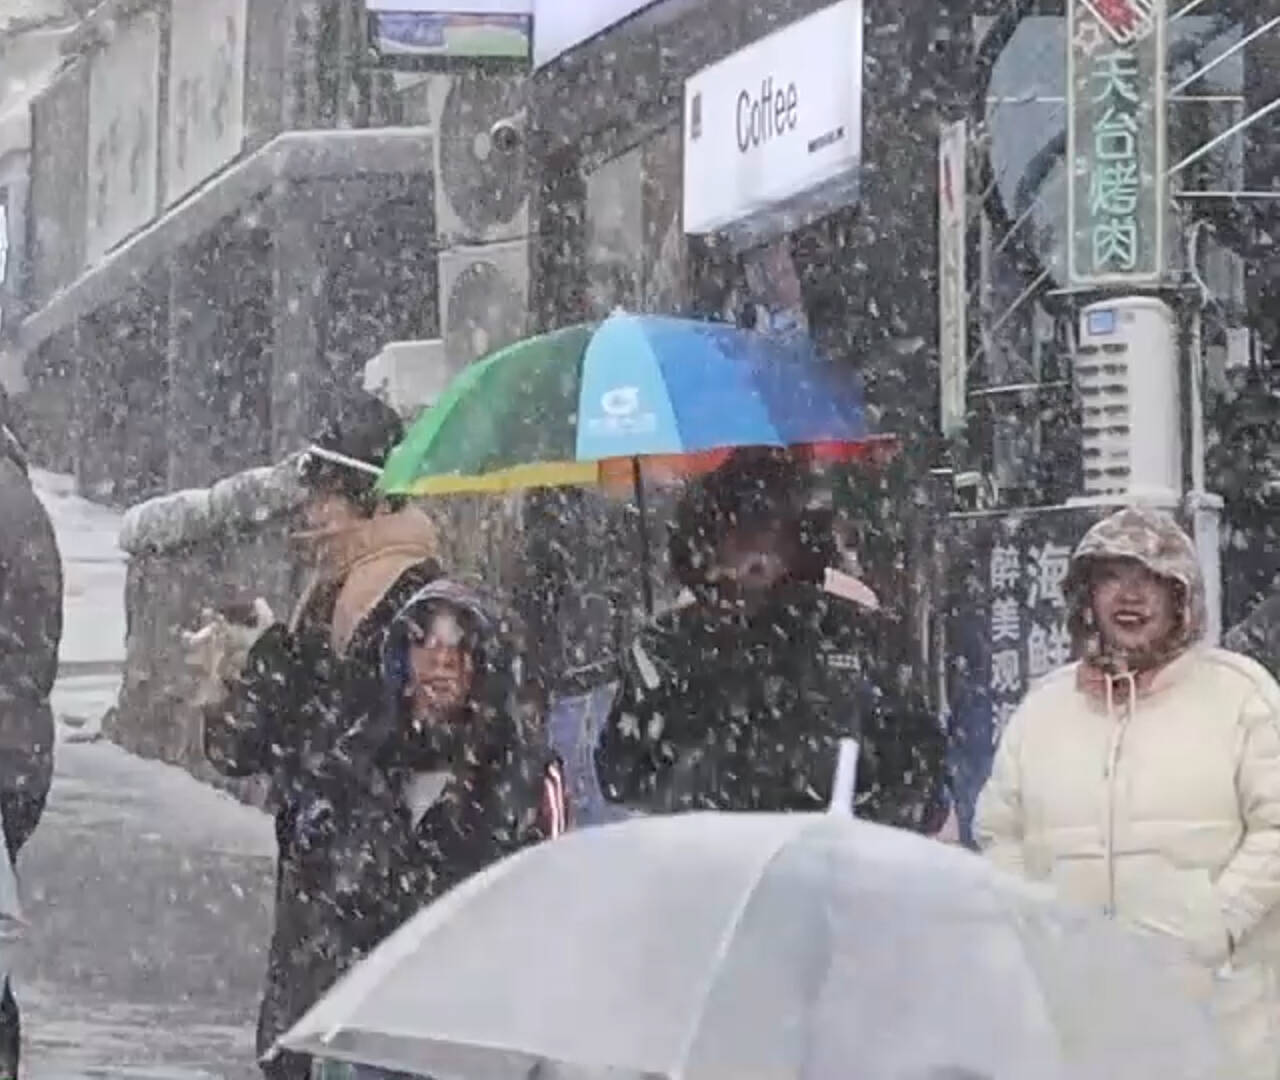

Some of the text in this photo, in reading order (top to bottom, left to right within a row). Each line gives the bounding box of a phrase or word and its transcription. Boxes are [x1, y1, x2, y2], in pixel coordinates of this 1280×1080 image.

[735, 76, 798, 153] Coffee
[1090, 51, 1139, 272] 天台烤肉
